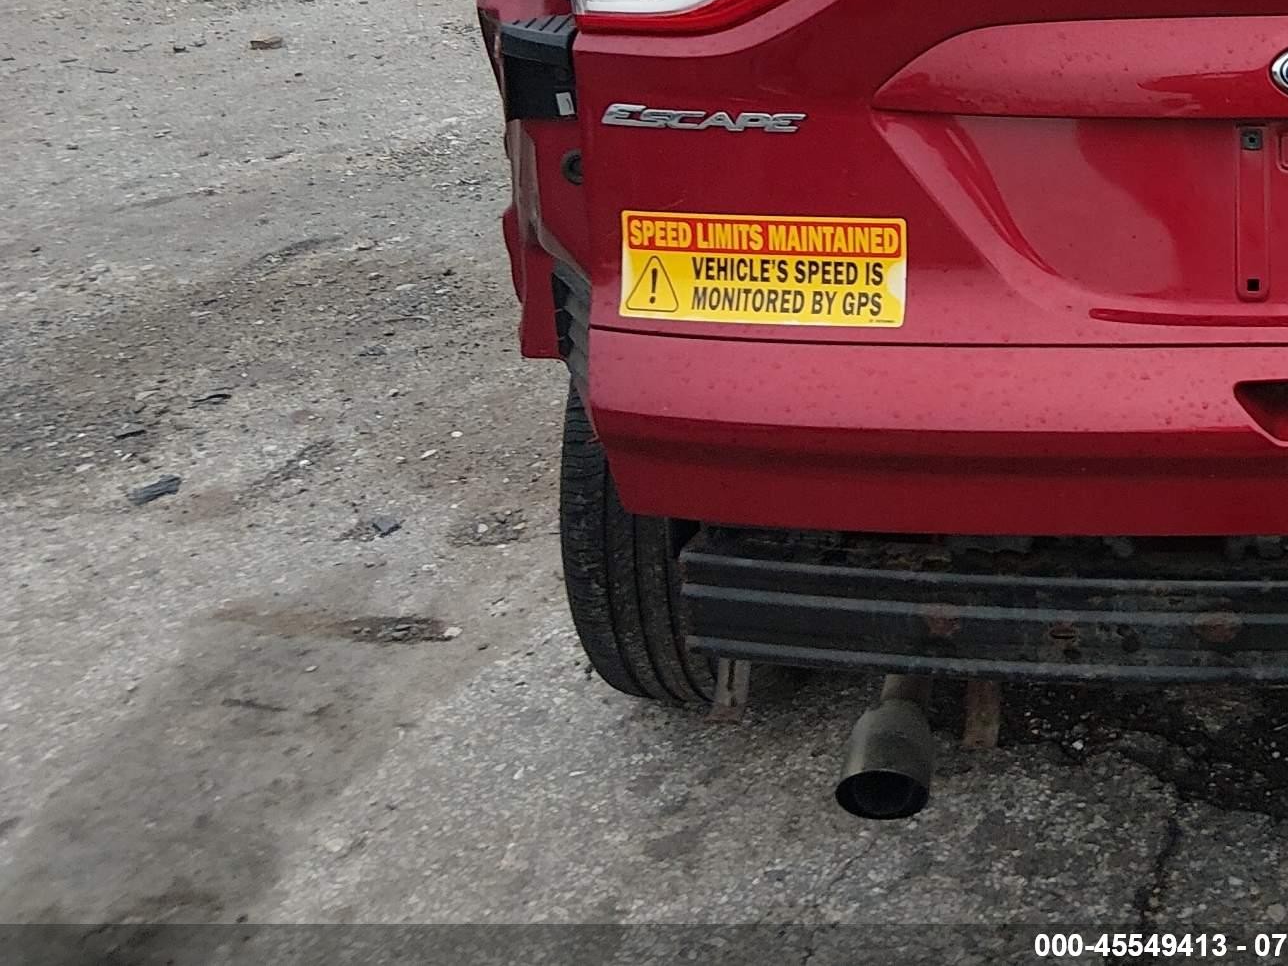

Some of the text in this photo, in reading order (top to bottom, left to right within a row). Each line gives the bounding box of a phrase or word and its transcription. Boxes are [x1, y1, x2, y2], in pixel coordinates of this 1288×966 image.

[601, 103, 806, 133] ESCAPE
[629, 218, 899, 254] SPEED LIMITS MAINTAINED
[692, 257, 884, 286] VEHICLE'S SPEED IS
[691, 286, 883, 317] MONITORED BY GPS
